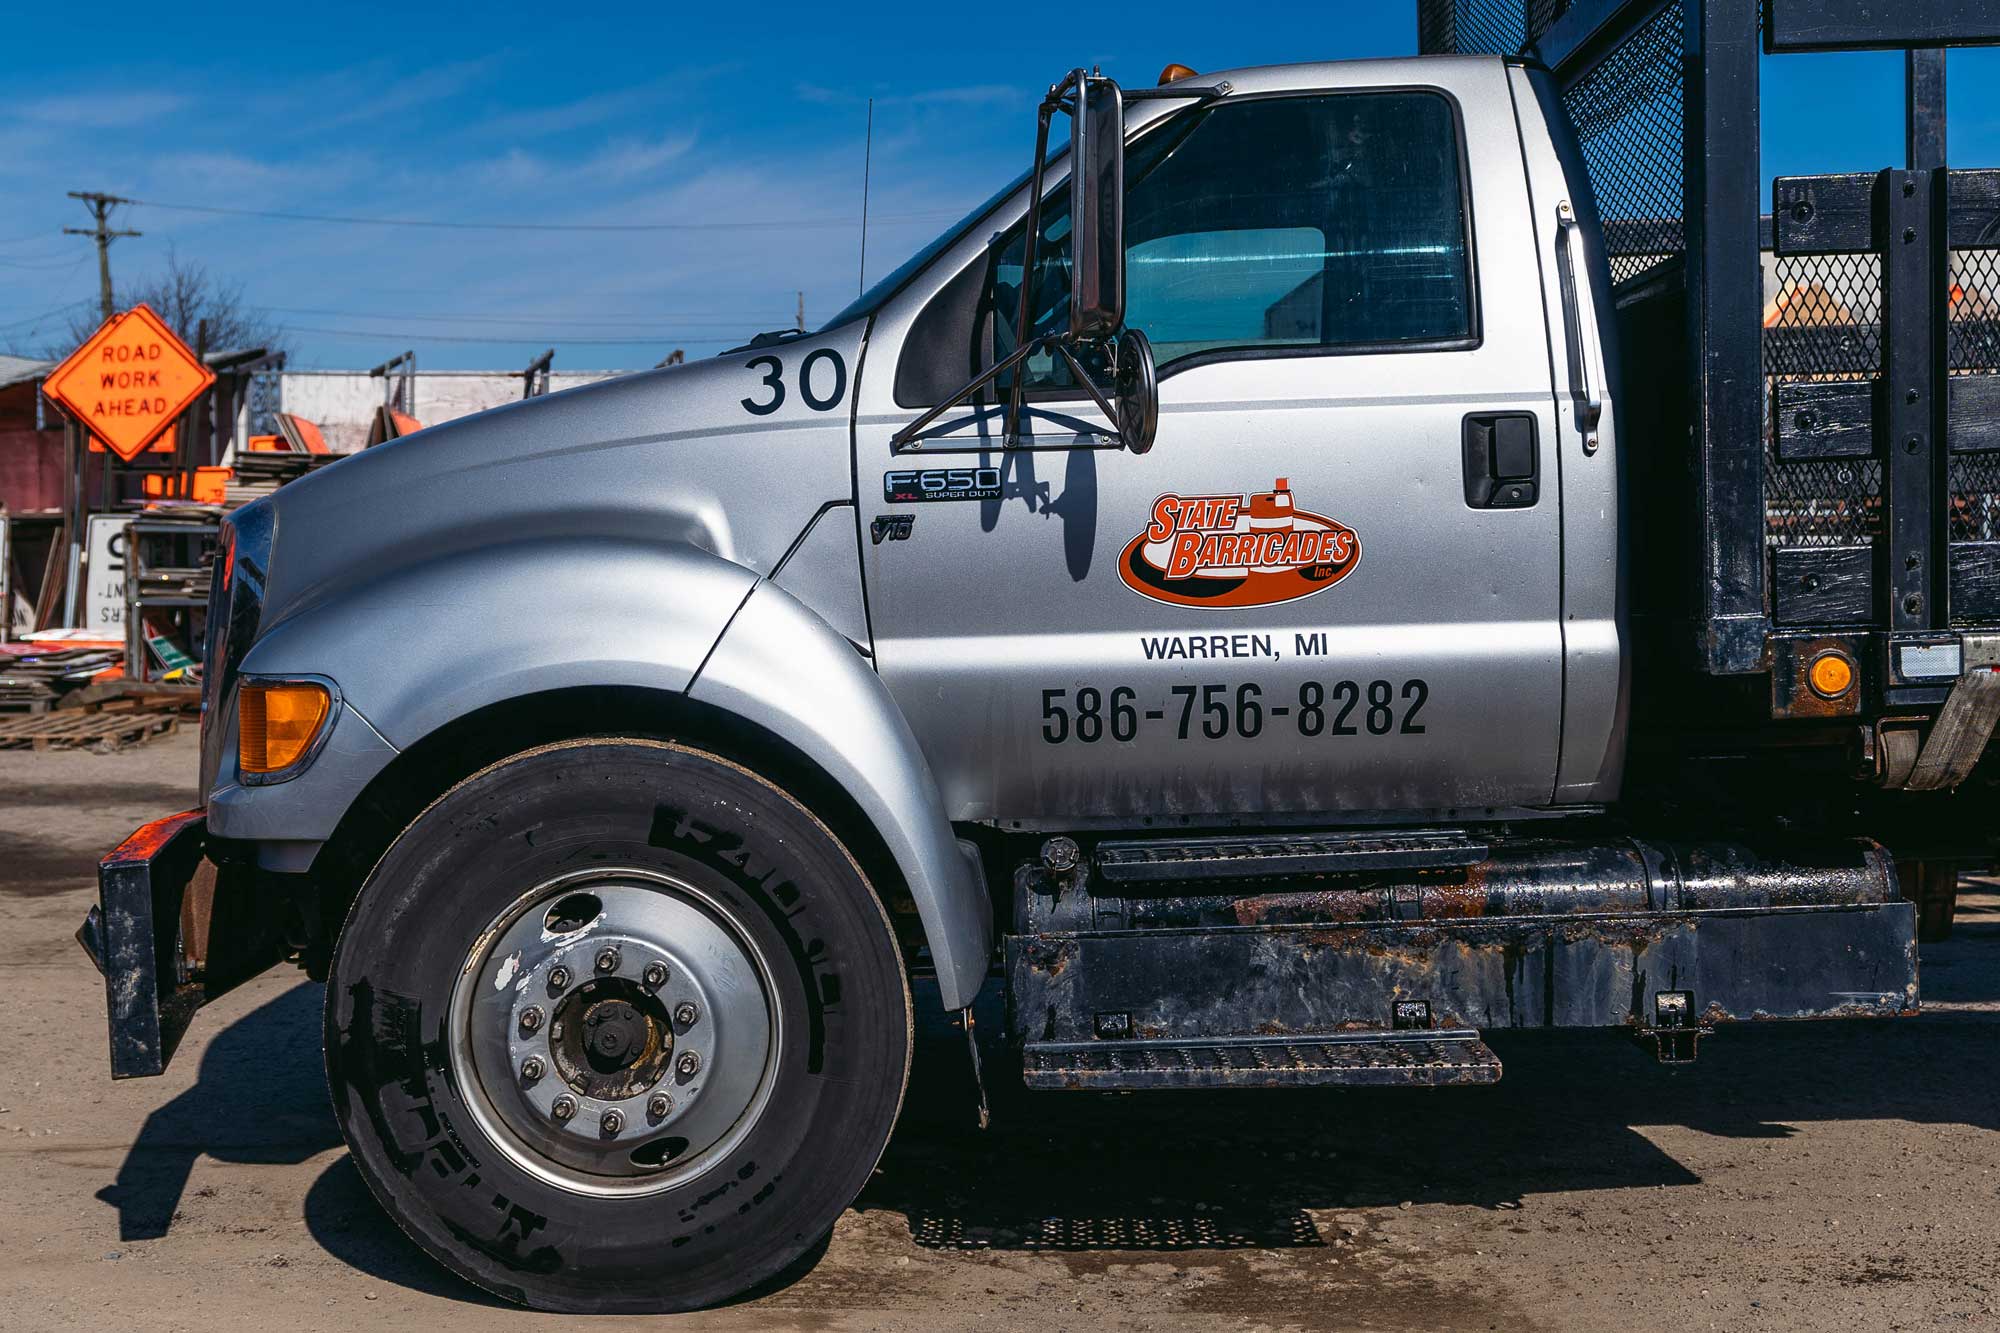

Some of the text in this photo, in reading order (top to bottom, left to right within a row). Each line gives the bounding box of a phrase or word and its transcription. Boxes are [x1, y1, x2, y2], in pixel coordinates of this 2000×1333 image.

[101, 344, 161, 363] ROAD
[100, 369, 161, 389] WORK
[740, 348, 847, 415] 30
[92, 397, 167, 417] AHEAD
[925, 491, 965, 499] SUPER
[969, 490, 1000, 498] DUTY
[1148, 497, 1240, 542] STATE
[1167, 530, 1356, 579] BARRICADES
[1141, 632, 1328, 662] WARREN, MI
[1042, 678, 1430, 744] 586-756-8282
